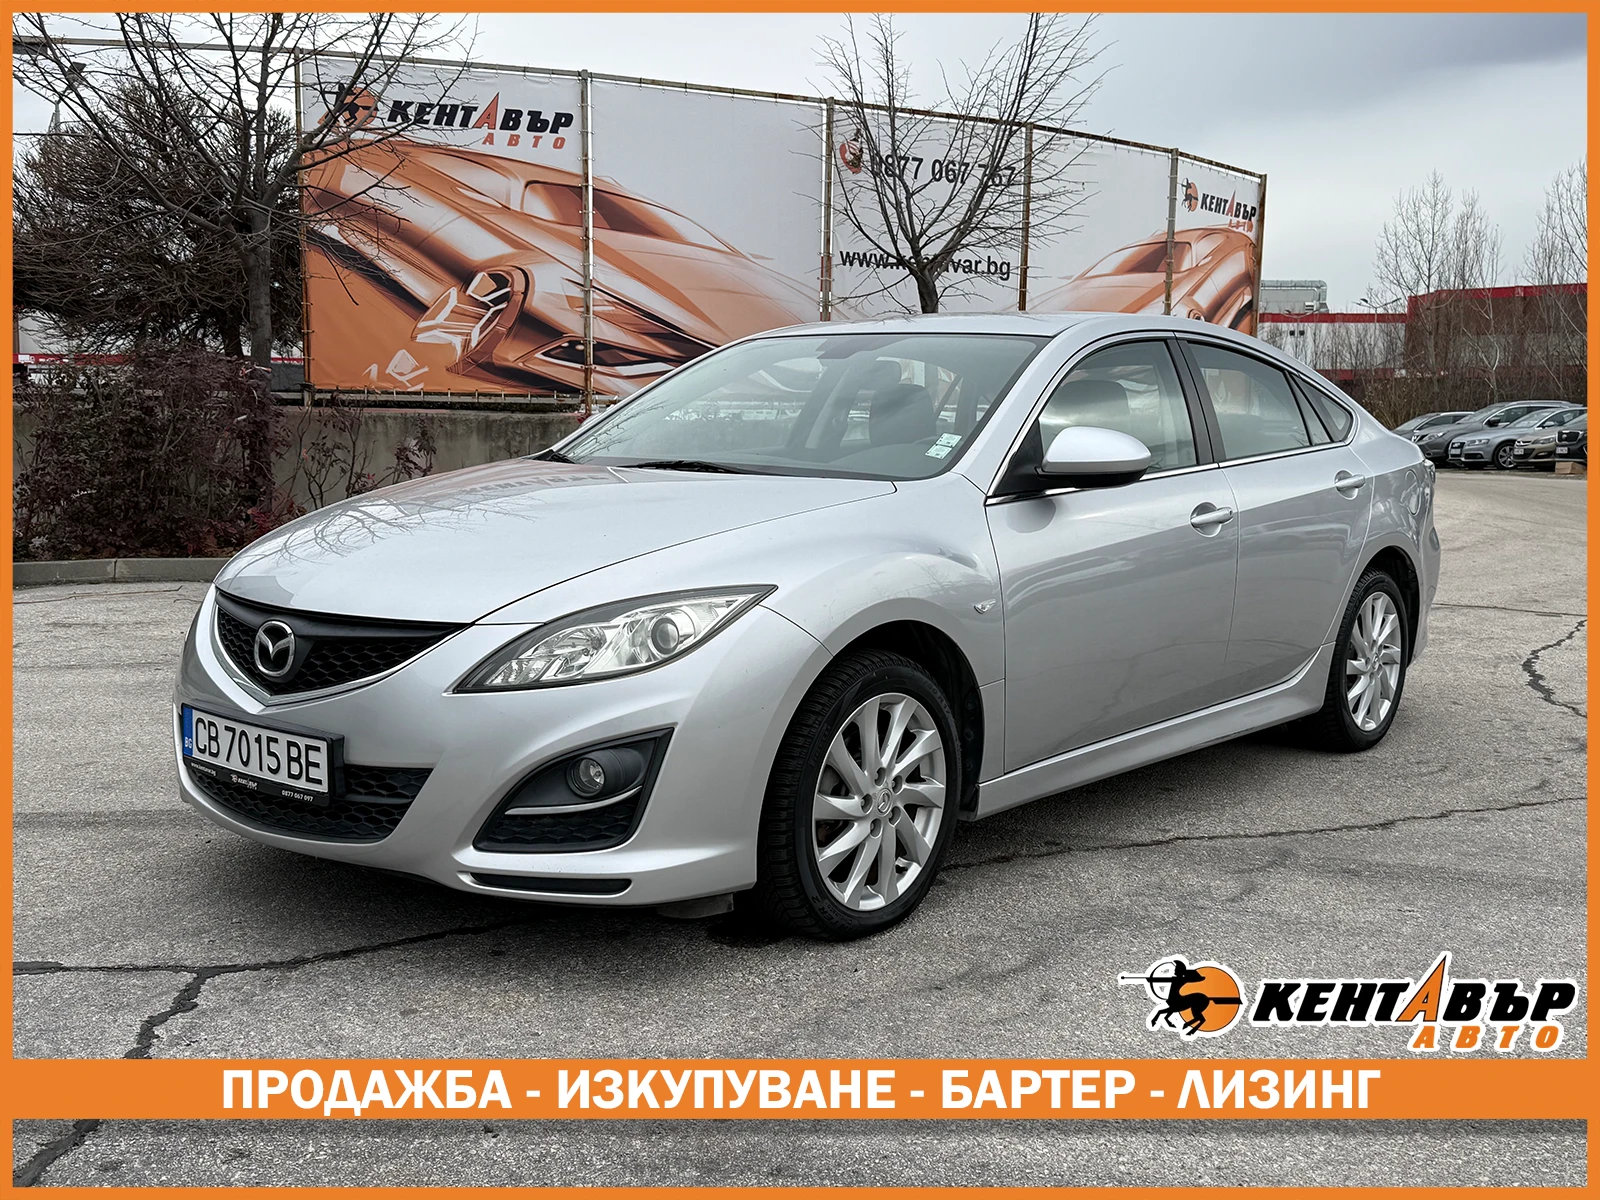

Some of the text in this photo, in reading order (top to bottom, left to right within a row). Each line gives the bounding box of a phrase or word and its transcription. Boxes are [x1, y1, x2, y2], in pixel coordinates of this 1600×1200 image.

[387, 92, 574, 134] КЕНТАВЪР
[482, 133, 566, 149] АВТО
[1200, 189, 1257, 221] КЕНТАВЪР
[184, 736, 193, 749] BG
[224, 725, 281, 775] 7015
